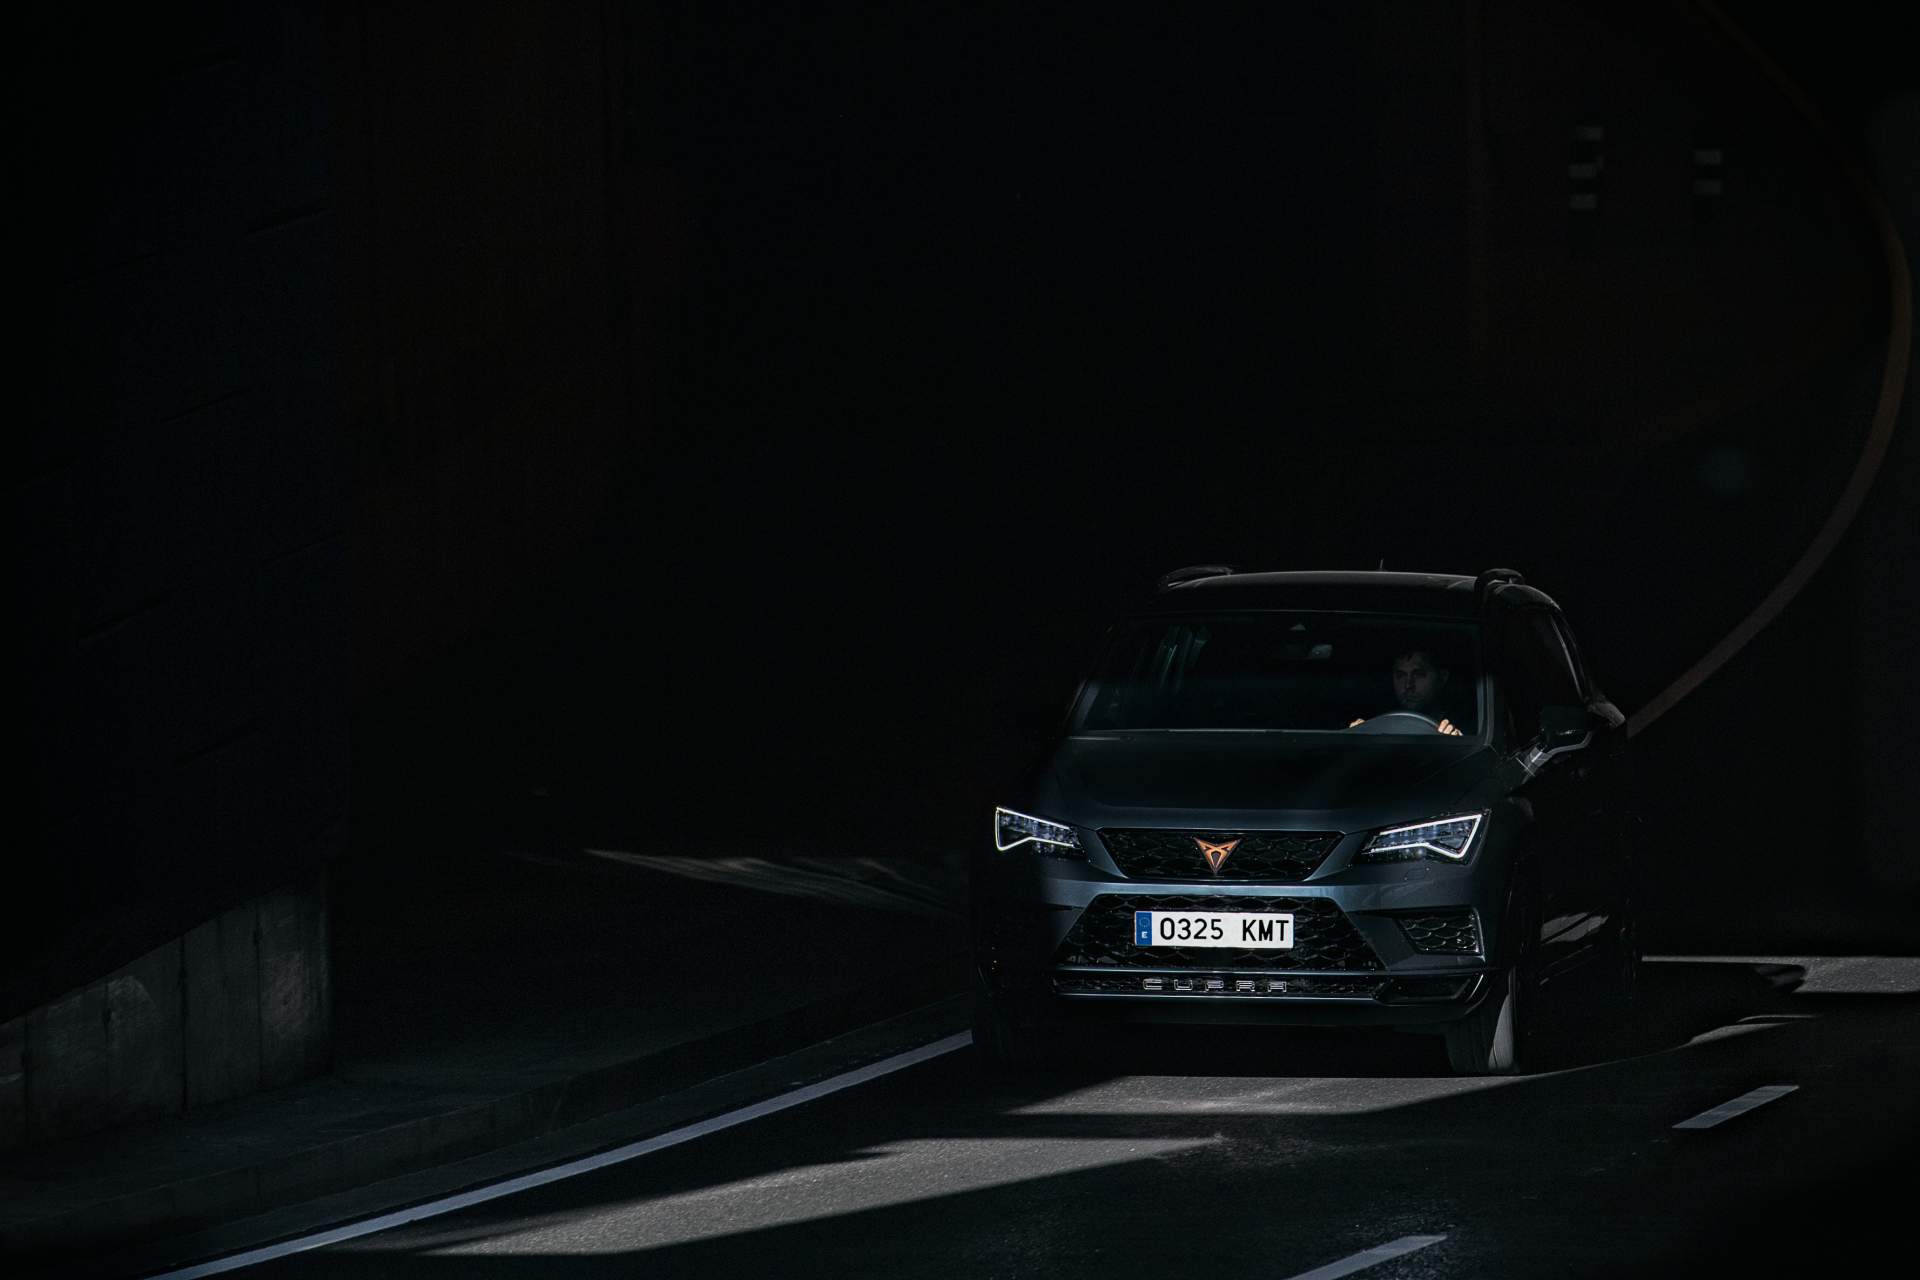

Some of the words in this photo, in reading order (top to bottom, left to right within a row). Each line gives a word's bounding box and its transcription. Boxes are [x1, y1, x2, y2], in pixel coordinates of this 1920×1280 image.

[1141, 931, 1148, 939] E
[1160, 917, 1224, 940] 0325
[1242, 919, 1289, 942] KMT
[1142, 978, 1287, 992] CUPRA
